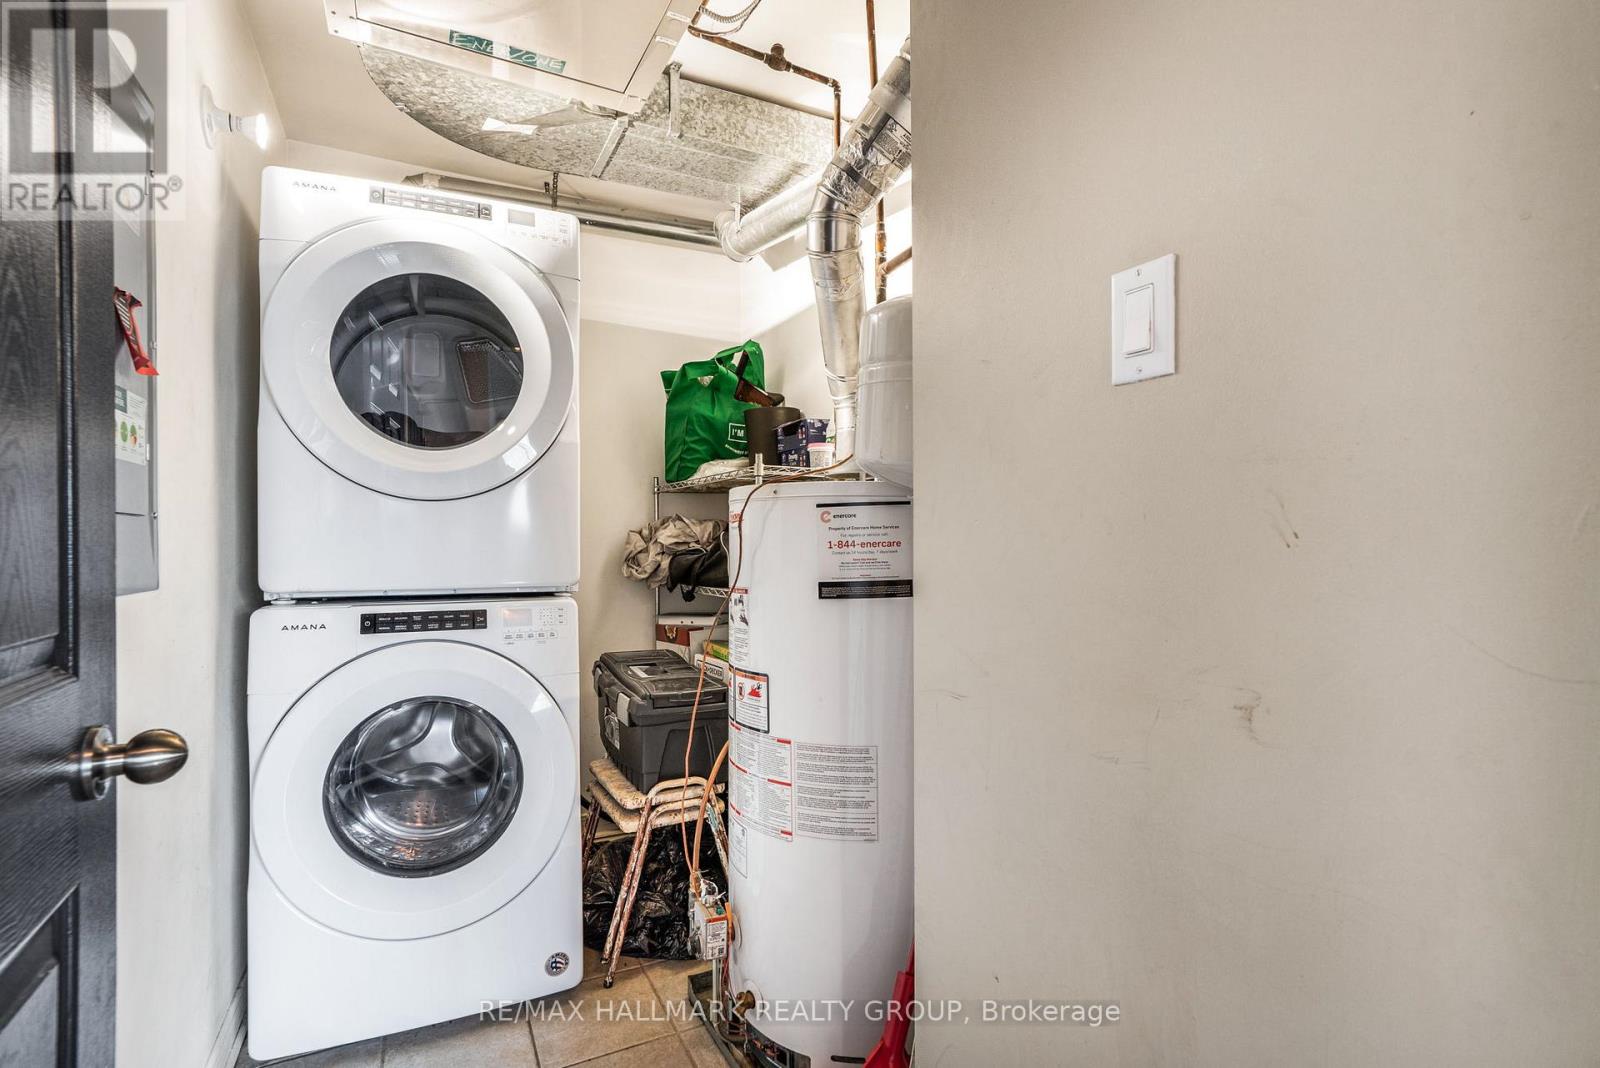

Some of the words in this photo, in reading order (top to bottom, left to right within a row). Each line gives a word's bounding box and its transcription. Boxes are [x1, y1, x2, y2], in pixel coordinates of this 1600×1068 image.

[293, 180, 337, 192] AMANA
[828, 540, 902, 549] 1-844-enercare
[281, 623, 327, 632] AMANA
